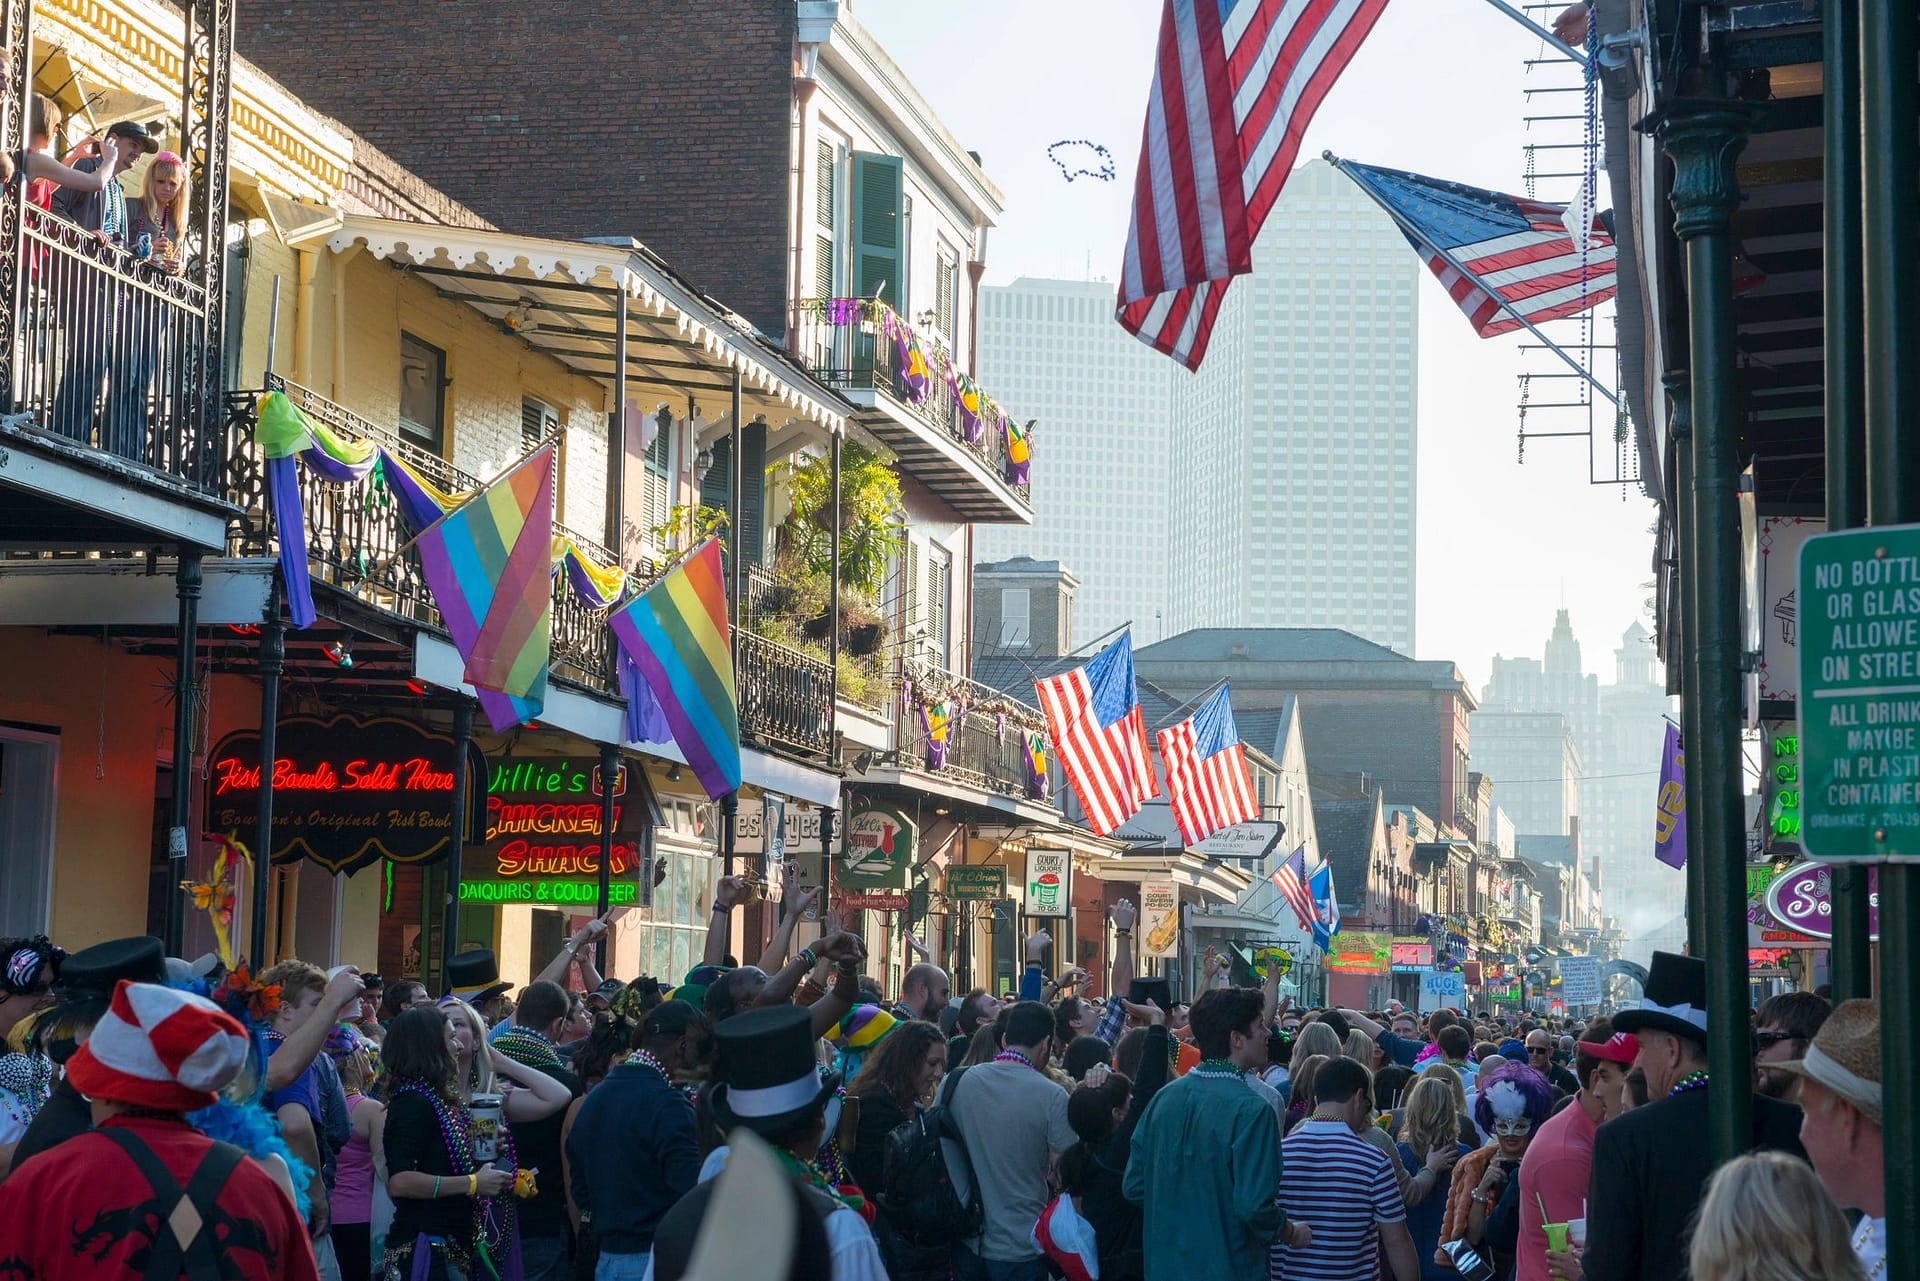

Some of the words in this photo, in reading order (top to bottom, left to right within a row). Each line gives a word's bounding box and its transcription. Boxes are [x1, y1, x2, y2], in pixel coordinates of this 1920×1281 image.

[1815, 562, 1842, 589] NO
[1852, 556, 1920, 586] BOTTL
[1827, 593, 1853, 619] OR
[1863, 587, 1920, 617] GLAS
[1831, 620, 1918, 650] ALLOWE
[1822, 655, 1849, 682] ON
[1859, 651, 1920, 680] STRE
[1829, 704, 1859, 727] ALL
[217, 758, 260, 795] Fish
[271, 758, 337, 790] Bowls
[342, 758, 399, 790] Sold
[404, 758, 454, 790] Here
[488, 761, 586, 793] illie's
[1833, 757, 1850, 779] IN
[1858, 753, 1919, 779] PLASTI
[218, 809, 302, 827] Bouron's
[308, 809, 379, 831] Original
[387, 810, 415, 830] Fish
[419, 811, 452, 828] Bowl
[1036, 854, 1059, 865] COURT
[459, 882, 532, 900] DAIQUIRIS
[536, 882, 549, 900] &
[553, 883, 593, 900] COLD
[596, 884, 636, 901] EER
[1426, 977, 1458, 989] HUGE
